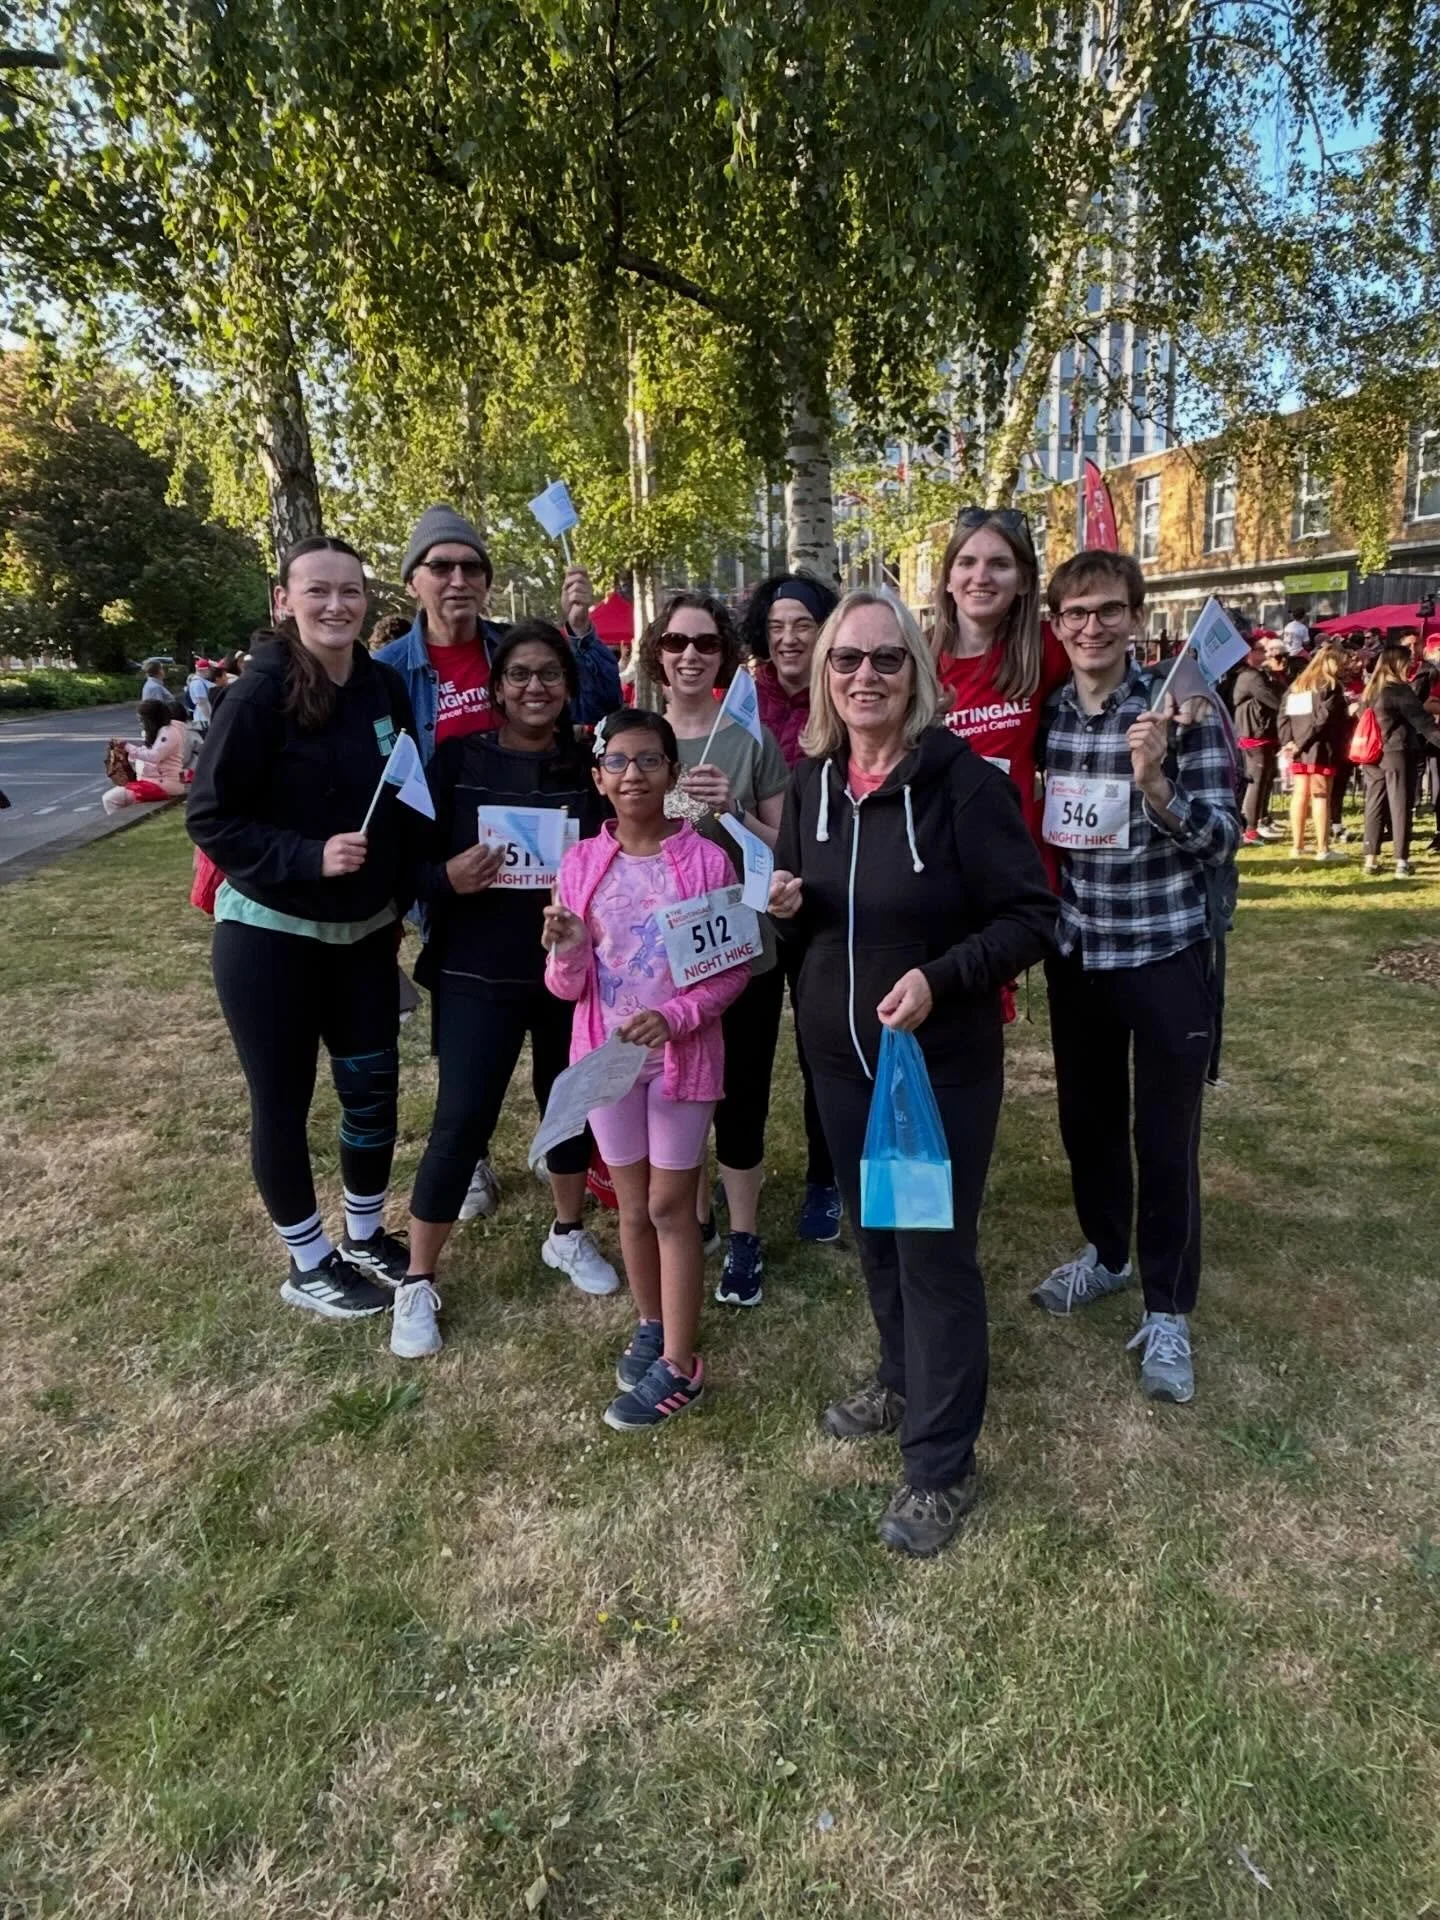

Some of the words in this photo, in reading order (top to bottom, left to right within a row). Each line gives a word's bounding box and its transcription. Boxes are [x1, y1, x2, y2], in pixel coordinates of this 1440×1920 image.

[438, 680, 457, 695] HE
[438, 686, 489, 711] IGHTIN
[942, 697, 1032, 727] HTINGALE
[988, 718, 1021, 731] Centre
[1062, 800, 1098, 828] 546
[1048, 830, 1082, 845] NIGHT
[1084, 833, 1119, 846] HIKE
[505, 842, 545, 867] 51
[691, 914, 732, 954] 512
[684, 954, 723, 981] NIGHT
[724, 942, 754, 964] HIKE
